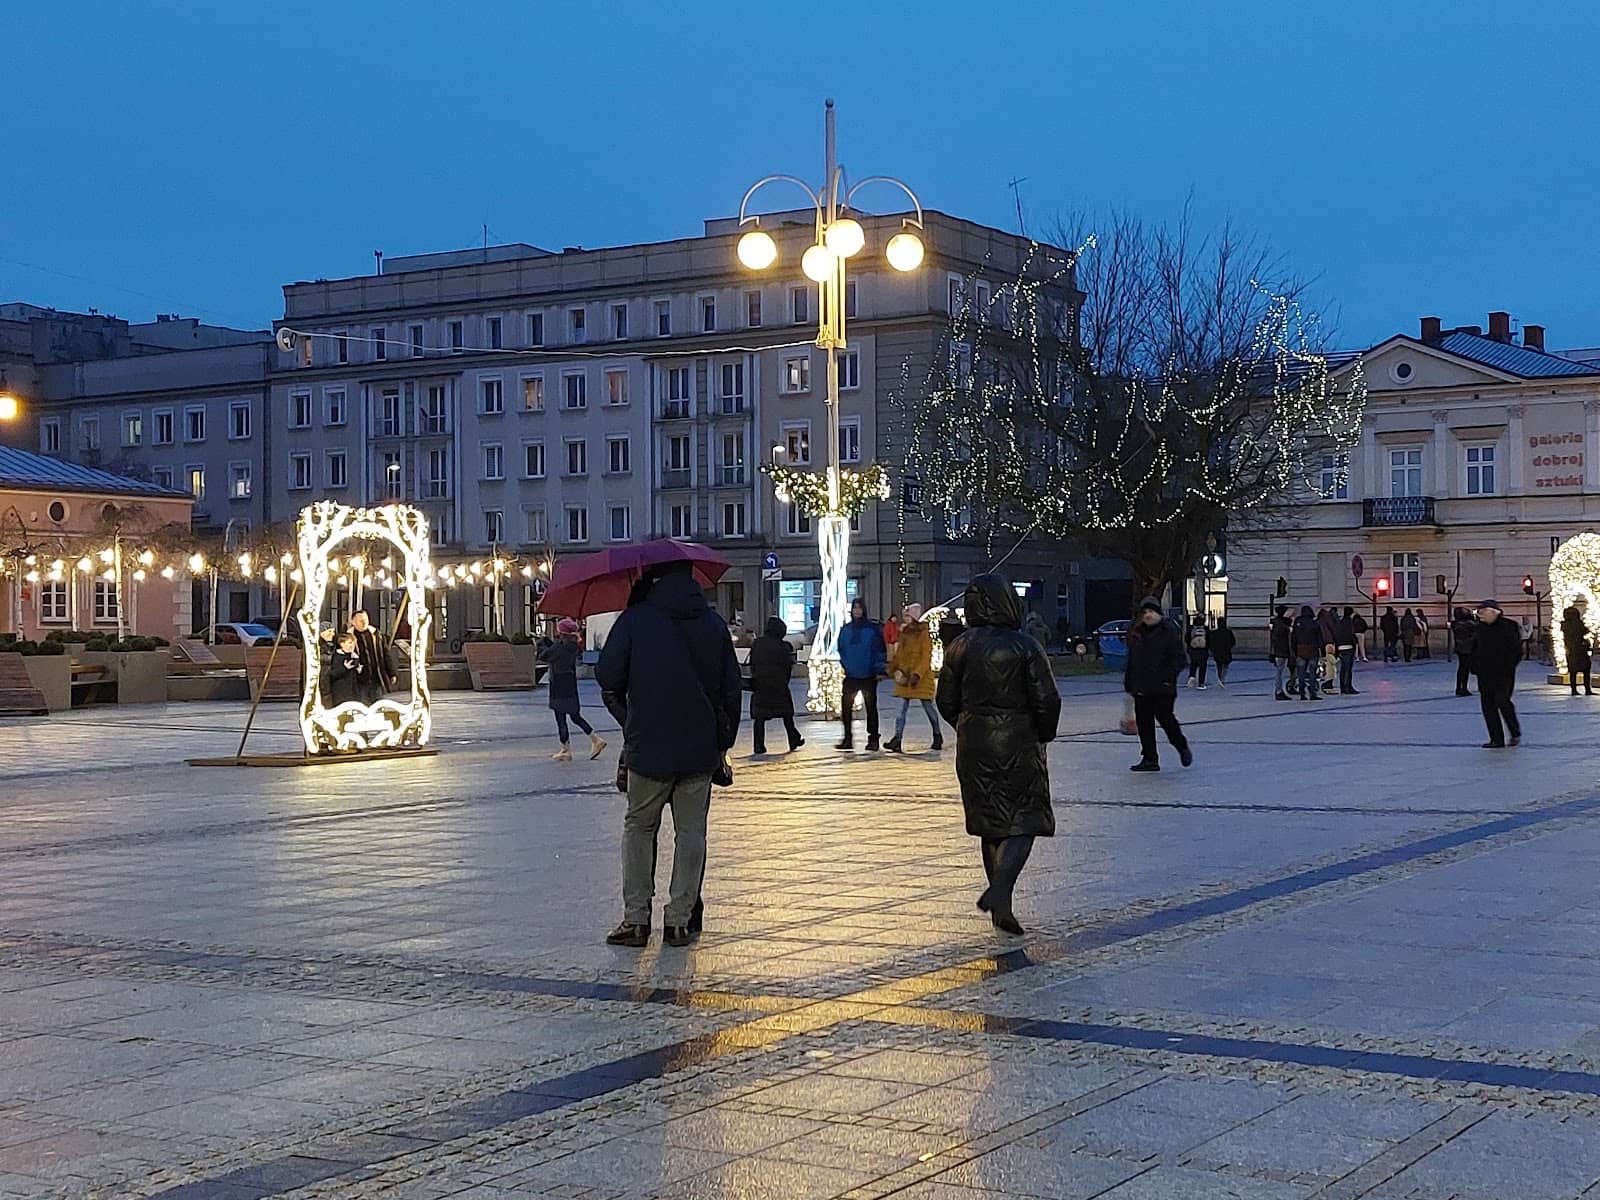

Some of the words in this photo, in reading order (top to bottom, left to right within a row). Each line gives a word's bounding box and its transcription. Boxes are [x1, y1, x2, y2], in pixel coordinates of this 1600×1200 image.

[1529, 432, 1583, 448] galeria
[1533, 453, 1583, 467] dobrej
[1536, 474, 1583, 487] sztuki
